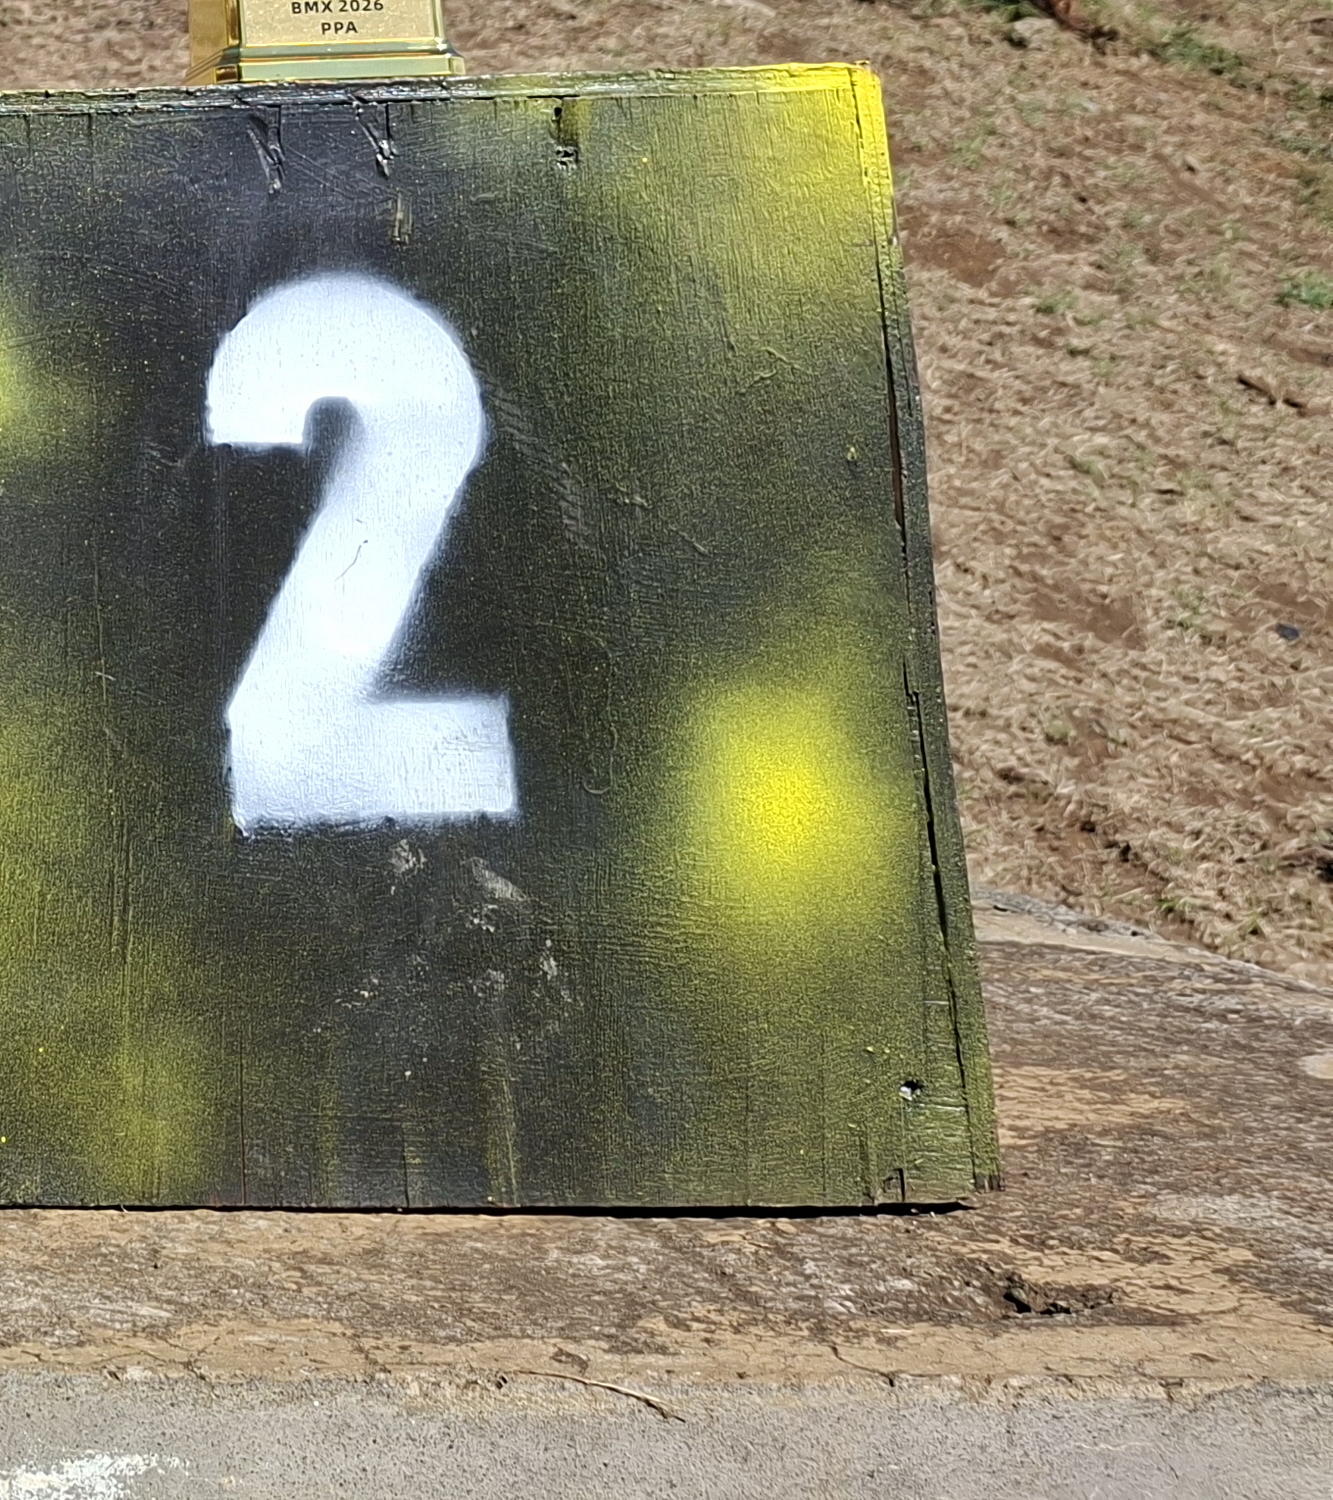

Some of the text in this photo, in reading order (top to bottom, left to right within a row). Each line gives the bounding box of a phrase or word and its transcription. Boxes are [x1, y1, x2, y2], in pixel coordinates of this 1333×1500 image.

[291, 0, 333, 14] BMX
[321, 21, 358, 35] PPA
[204, 271, 520, 835] 2
